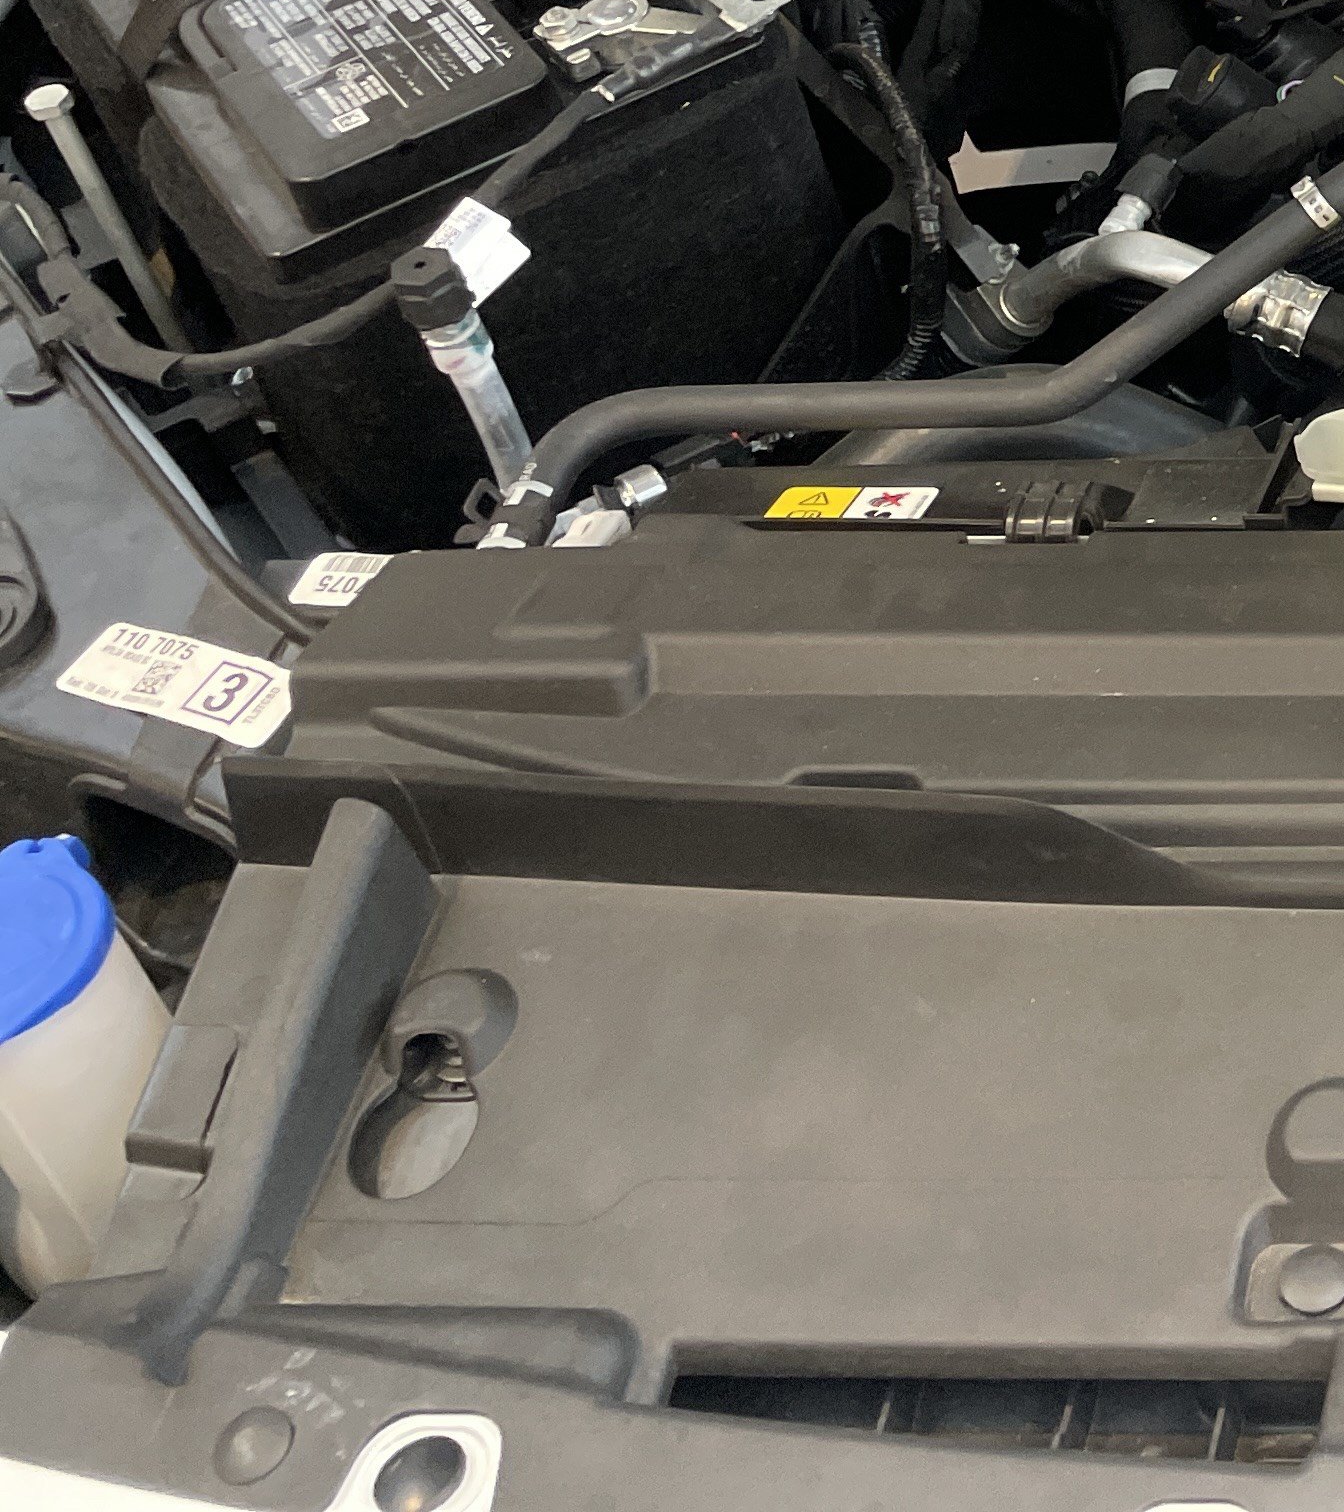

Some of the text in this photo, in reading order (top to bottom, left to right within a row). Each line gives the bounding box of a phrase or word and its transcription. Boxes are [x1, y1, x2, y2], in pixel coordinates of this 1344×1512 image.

[112, 628, 150, 651] 110
[157, 635, 200, 661] 7075
[202, 672, 249, 712] 3
